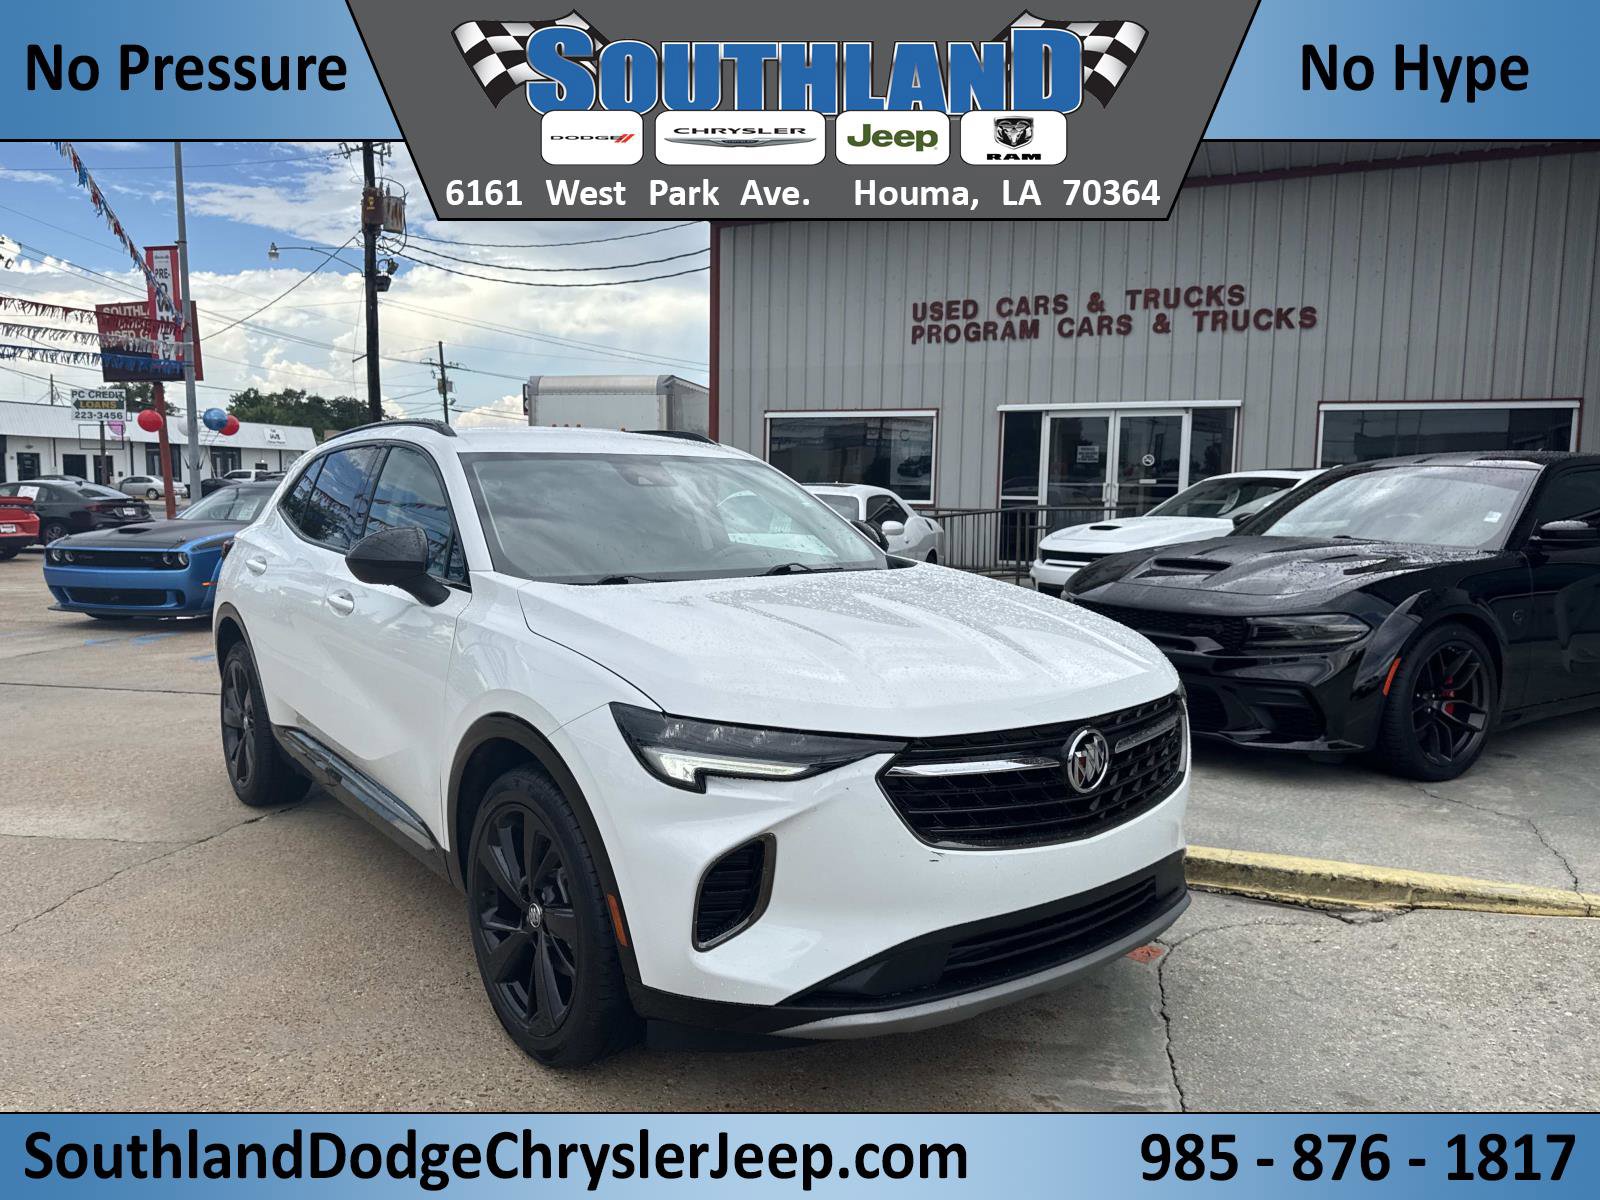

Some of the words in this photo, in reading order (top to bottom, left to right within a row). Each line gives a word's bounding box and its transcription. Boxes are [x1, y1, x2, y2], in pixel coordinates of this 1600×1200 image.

[912, 299, 979, 323] USED
[996, 294, 1069, 318] CARS
[1087, 291, 1106, 314] &
[1125, 284, 1245, 311] TRUCKS
[911, 319, 1041, 345] PROGRAM
[1057, 315, 1134, 338] CARS
[1152, 312, 1171, 335] &
[1192, 306, 1318, 332] TRUCKS
[71, 390, 86, 399] PC
[88, 390, 125, 399] CREDIT
[79, 400, 117, 410] LOANS
[74, 411, 124, 420] 223-3456
